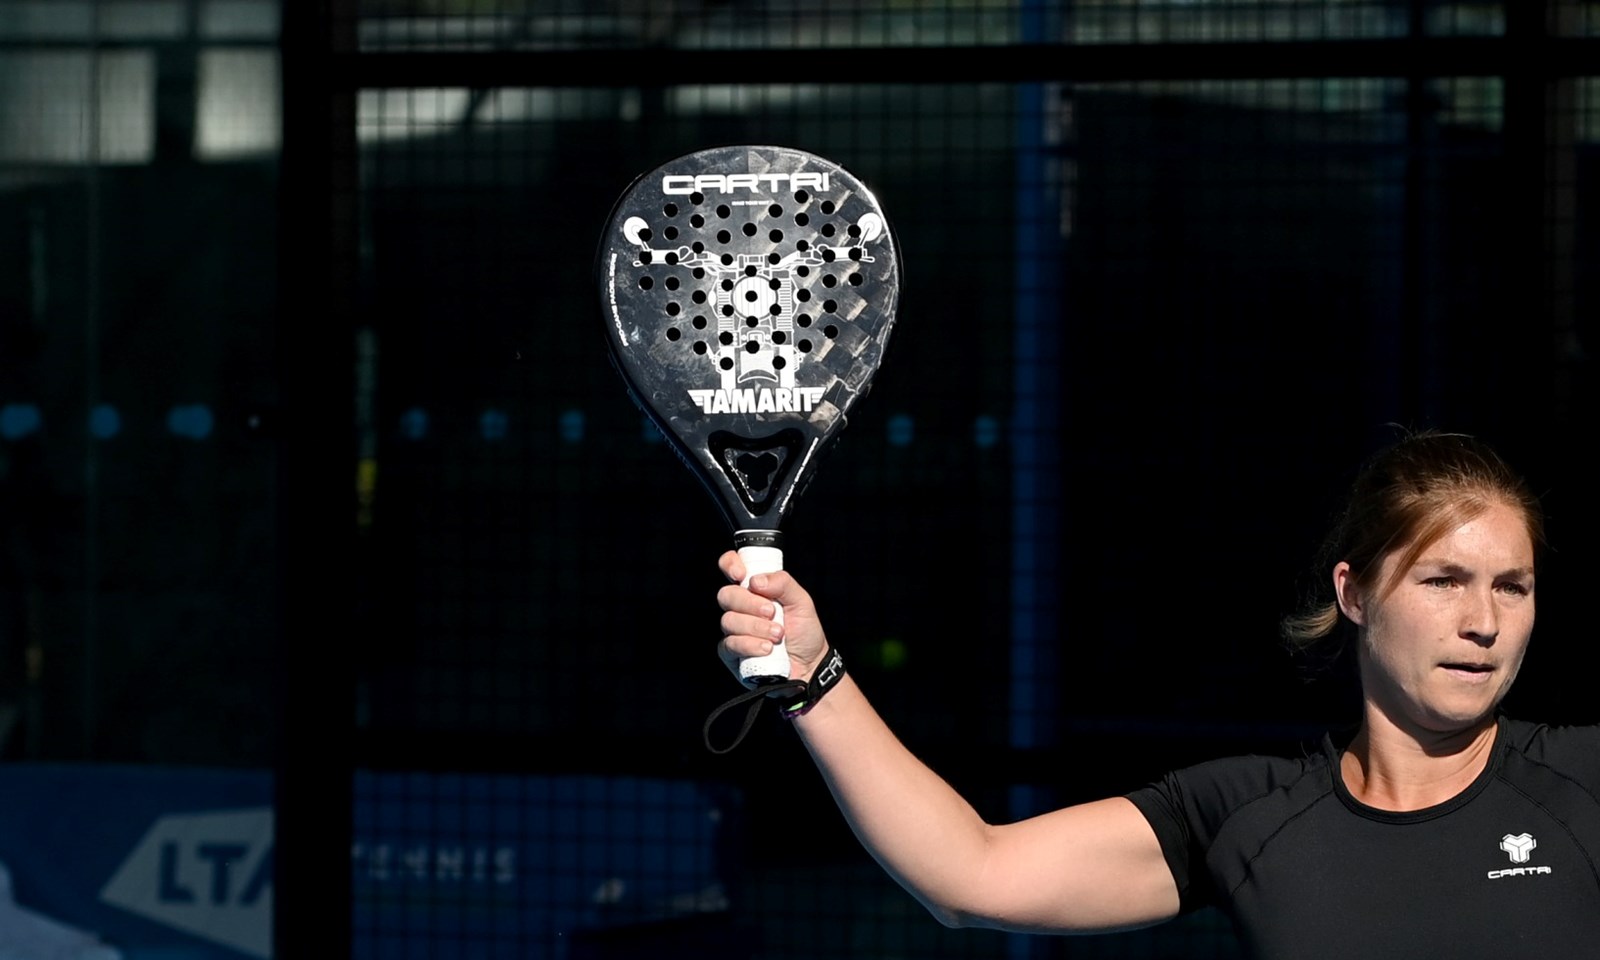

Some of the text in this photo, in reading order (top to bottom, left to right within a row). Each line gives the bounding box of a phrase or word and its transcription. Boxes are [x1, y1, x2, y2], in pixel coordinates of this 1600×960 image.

[662, 172, 830, 195] CARTRI
[690, 387, 825, 414] TAMARIT
[1487, 866, 1552, 879] CARTRI
